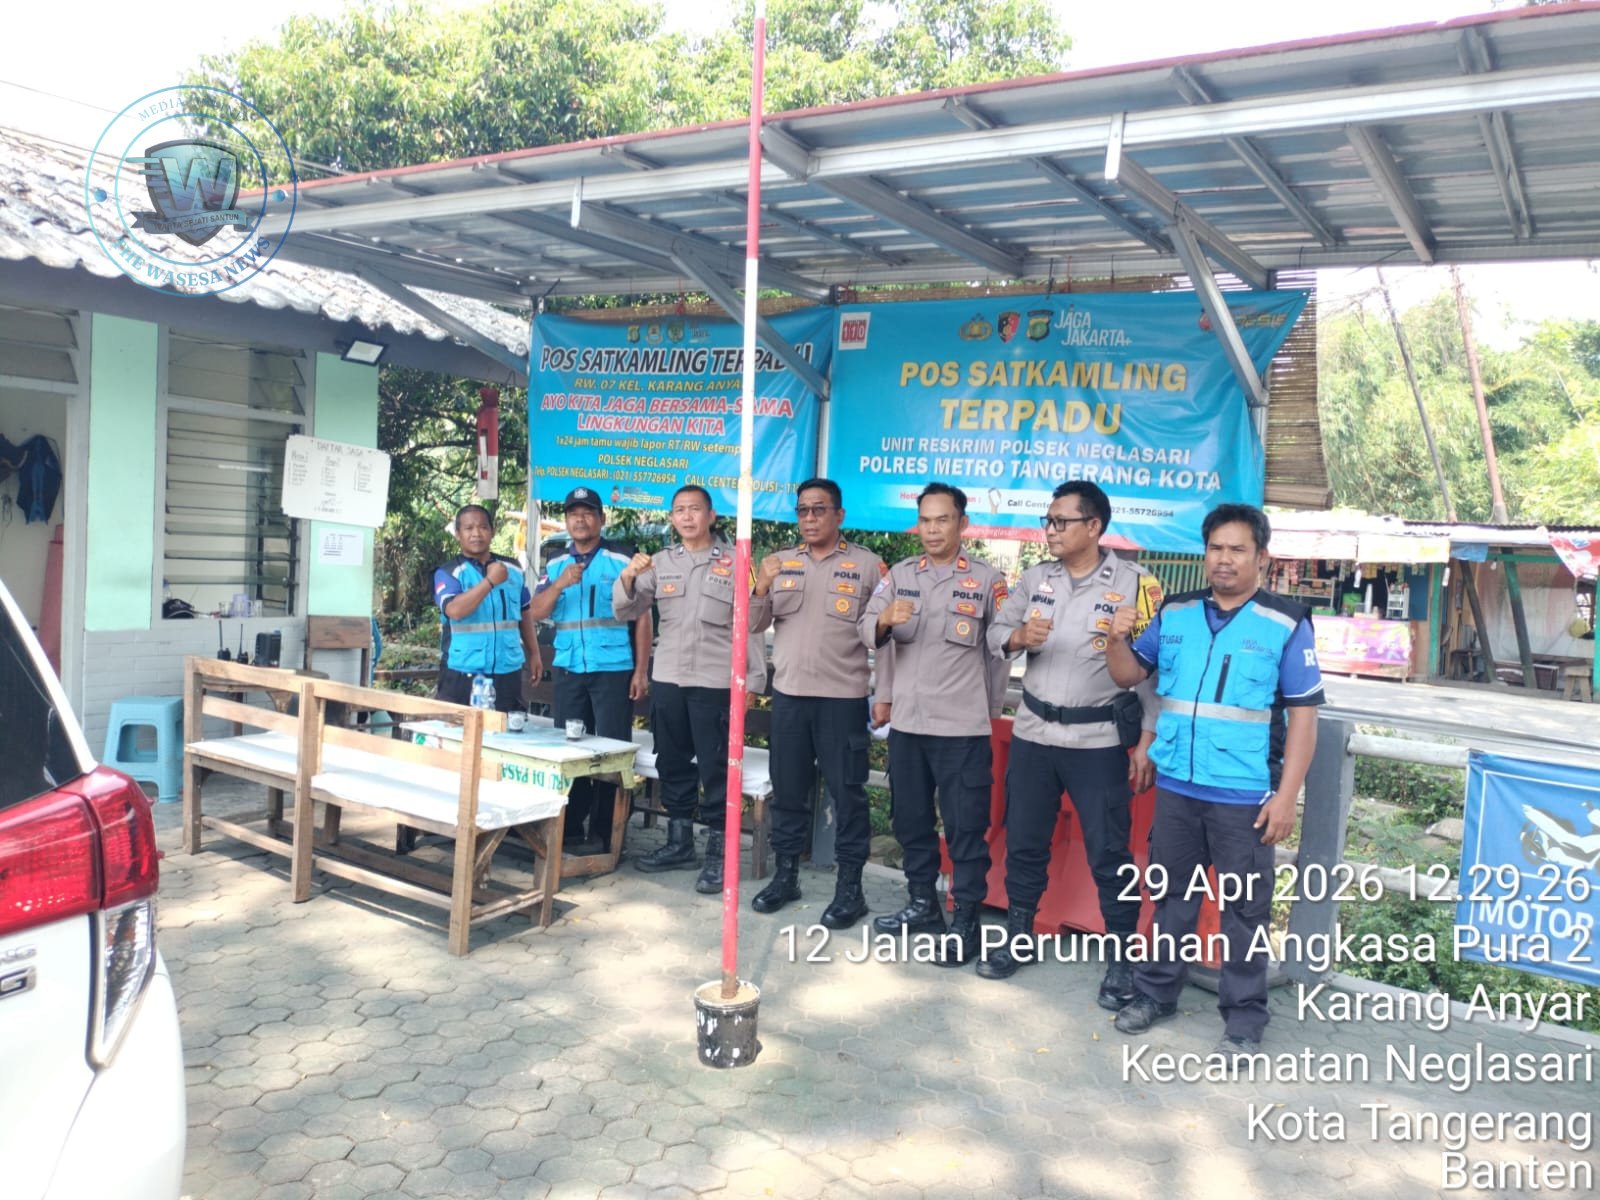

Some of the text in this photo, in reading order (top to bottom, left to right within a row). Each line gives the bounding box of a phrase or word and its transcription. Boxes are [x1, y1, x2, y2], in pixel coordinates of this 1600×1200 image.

[1054, 310, 1092, 329] JAGA
[540, 345, 578, 372] POS
[578, 347, 708, 375] SATKAMLING
[647, 381, 703, 392] KARANG
[706, 380, 741, 391] ANYA
[900, 360, 1187, 392] POS SATKAMLING
[541, 393, 794, 418] AYO KITA JAGA BERSAMA-SMA
[577, 413, 726, 437] LINGKUNGAN KITA
[940, 398, 1122, 435] TERPADU
[598, 453, 689, 469] POLSEK NEGLASARI
[881, 437, 1191, 465] UNIT RESKRIM POLSEK NEGLASARI
[684, 474, 706, 487] CALL
[707, 475, 740, 489] CENTE
[860, 455, 1222, 491] POLRES METRO TANGERANG KOTA
[833, 571, 861, 581] POLRI
[952, 590, 983, 601] POLRI
[1159, 634, 1184, 645] ETUGAS
